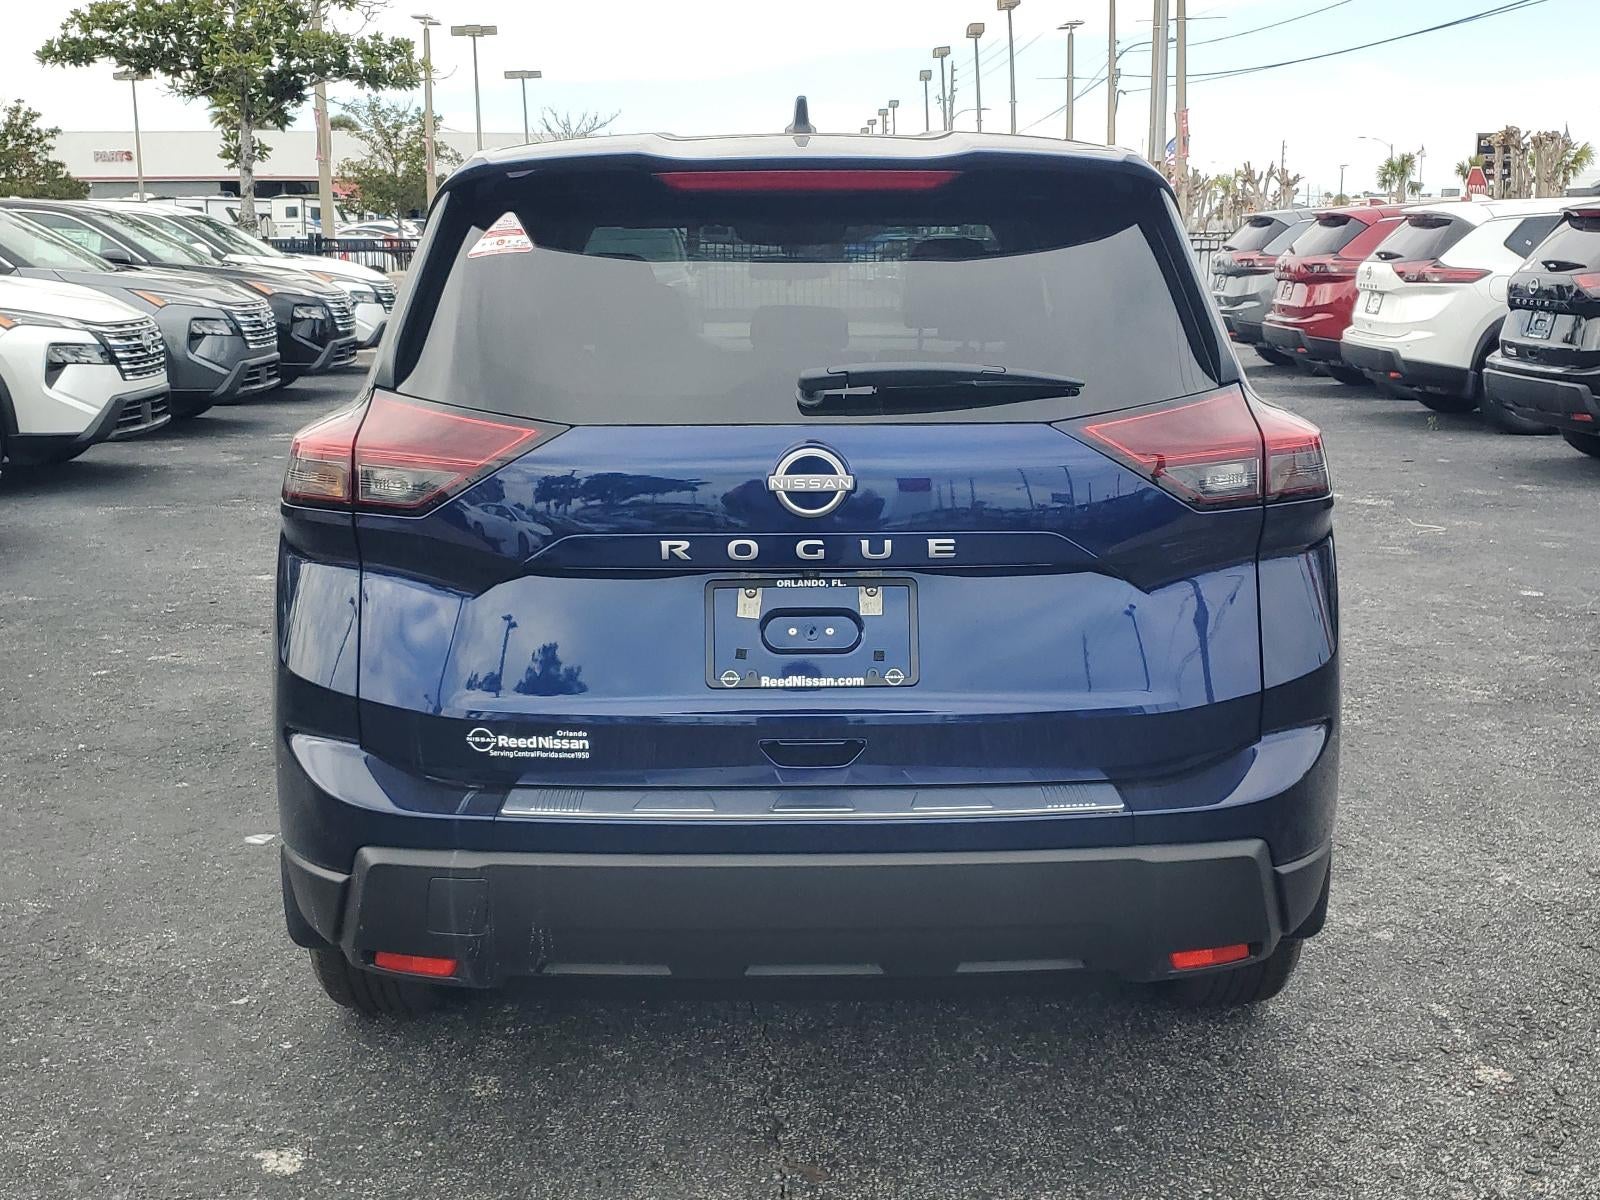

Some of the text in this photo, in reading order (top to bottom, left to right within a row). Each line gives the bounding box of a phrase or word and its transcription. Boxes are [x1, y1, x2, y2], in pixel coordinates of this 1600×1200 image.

[94, 150, 133, 162] PARTS
[770, 477, 852, 490] NISSAN
[660, 538, 957, 561] ROGUE
[776, 579, 847, 588] ORLANDO, FL.
[760, 675, 865, 688] ReedNissan.com
[556, 729, 588, 737] Orlando
